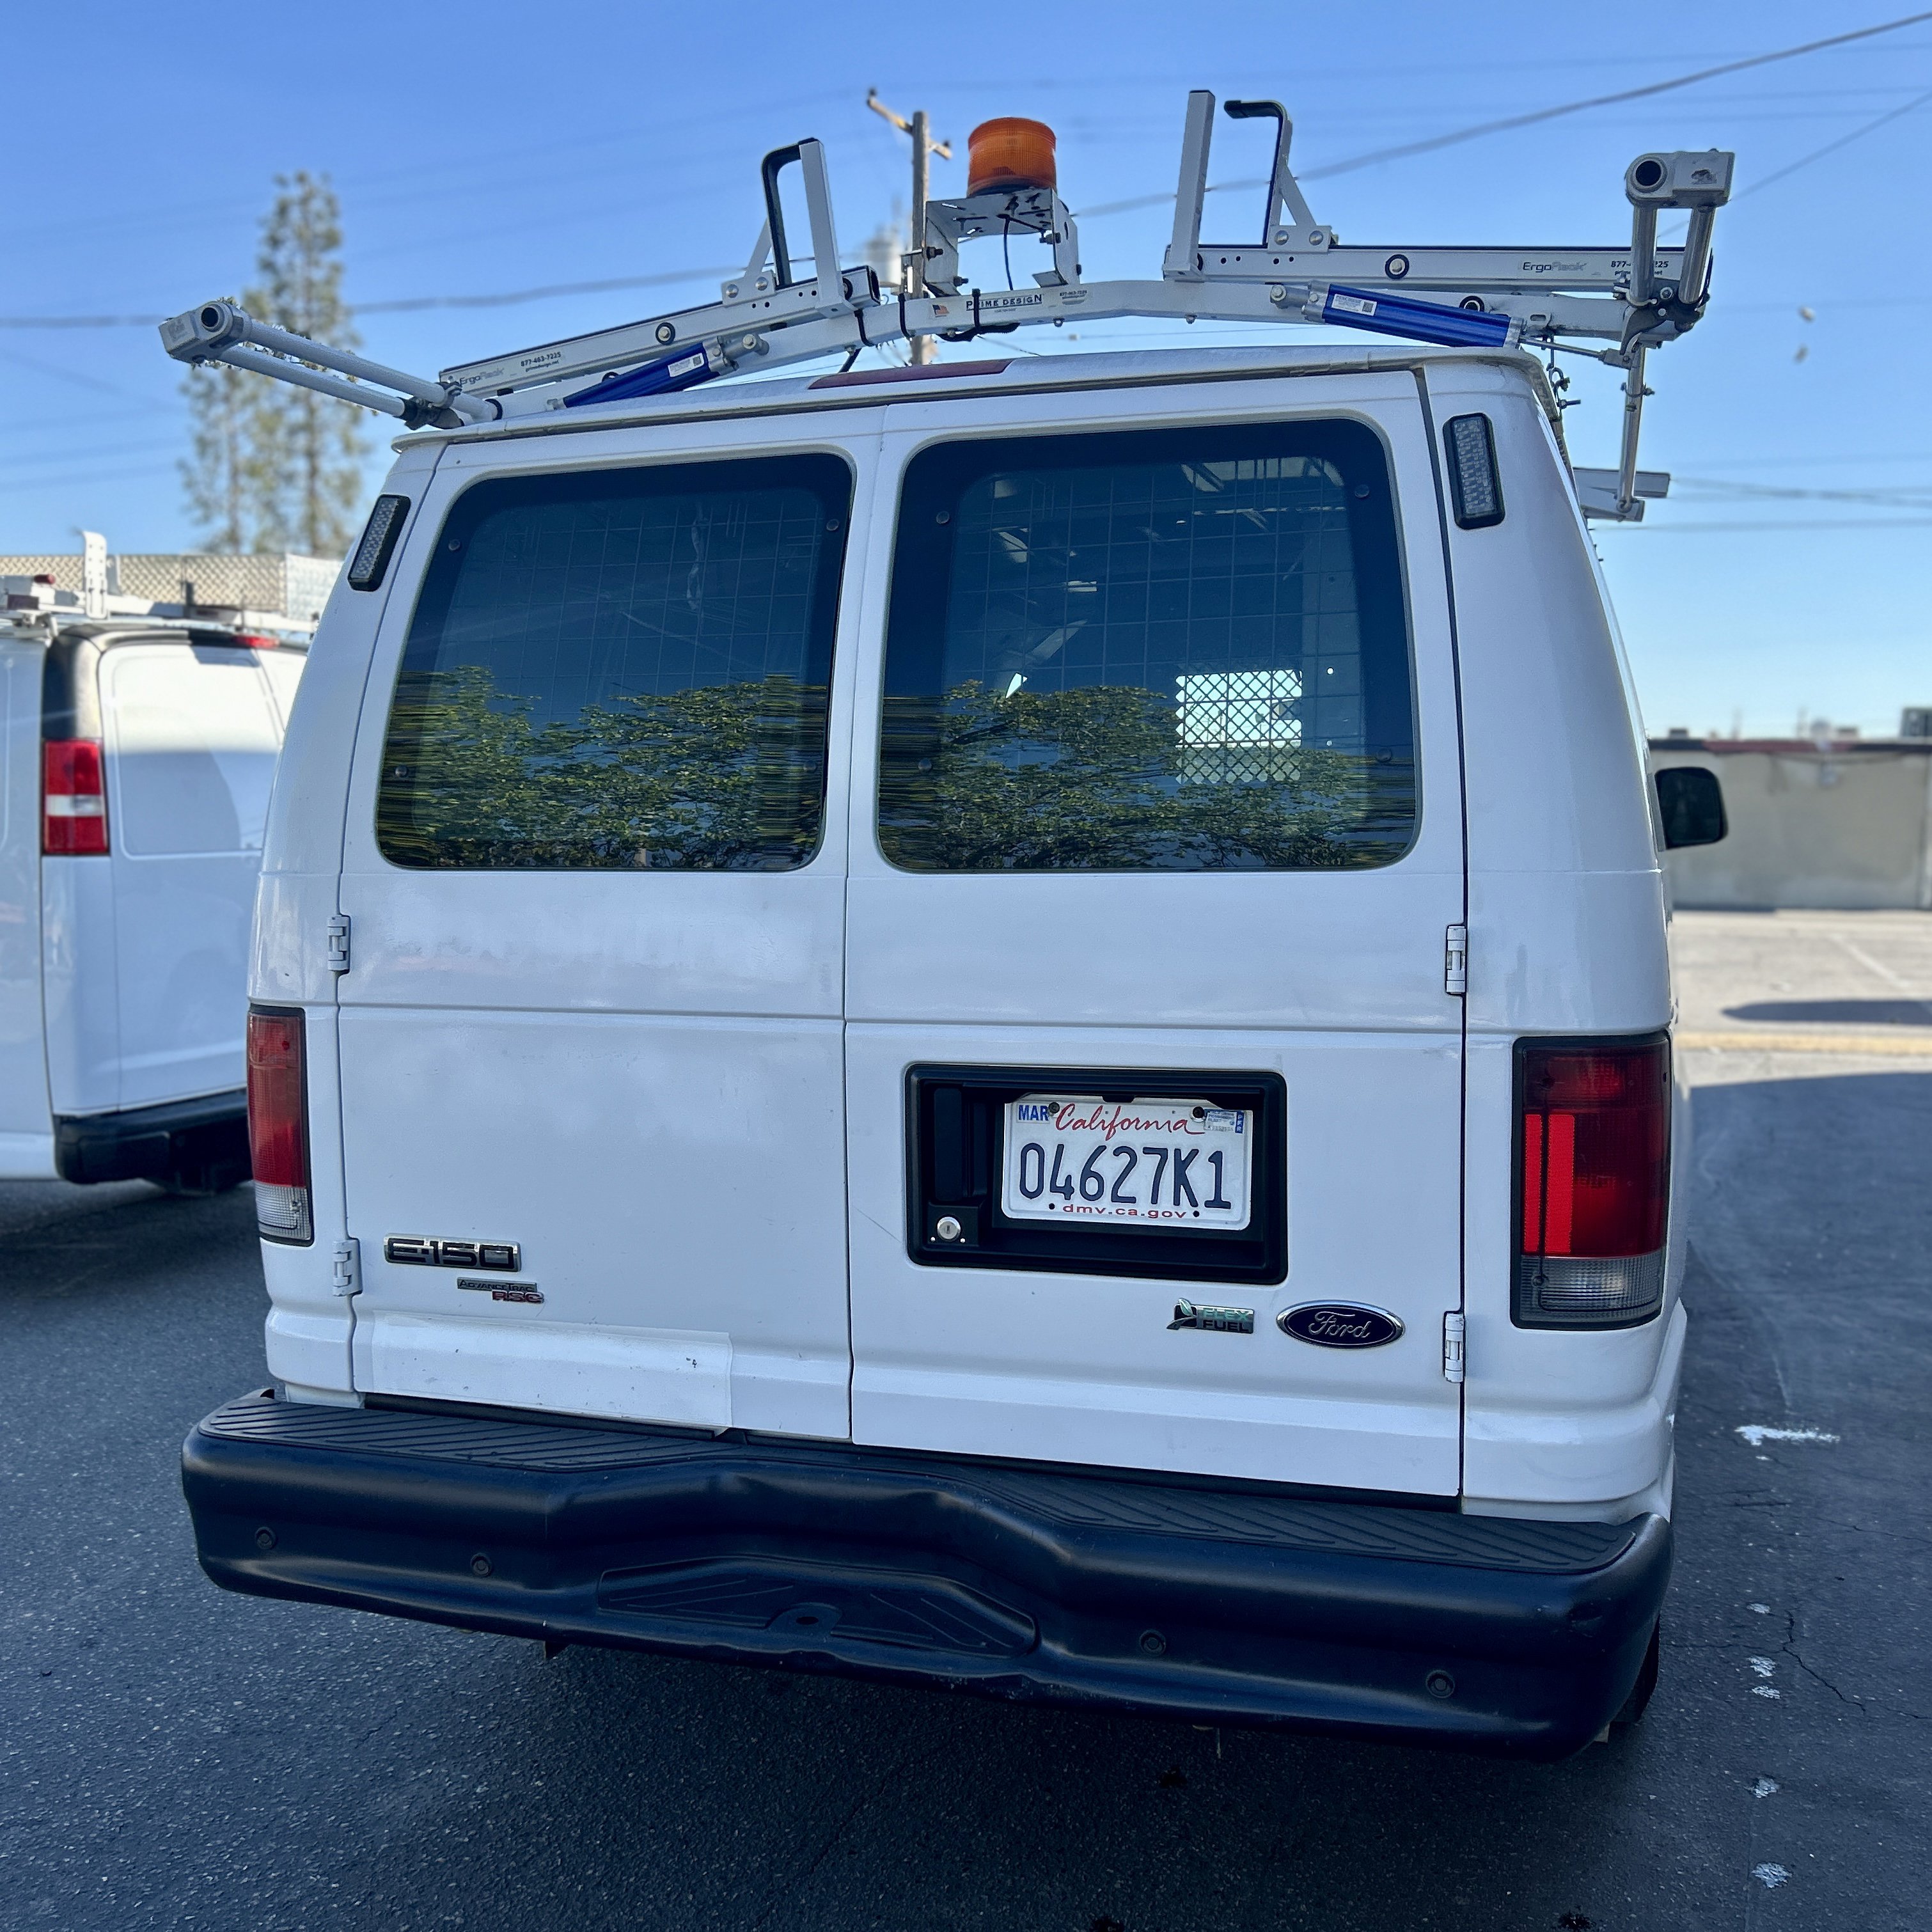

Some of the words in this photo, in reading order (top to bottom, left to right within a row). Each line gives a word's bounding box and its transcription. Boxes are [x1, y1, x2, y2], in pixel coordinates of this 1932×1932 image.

[966, 300, 998, 311] PIME
[1003, 294, 1042, 306] DESIGN
[521, 352, 562, 366] 877-463-7225
[1019, 1104, 1049, 1121] MAR
[1055, 1103, 1206, 1141] California
[1019, 1142, 1232, 1209] 04627K1
[1063, 1204, 1187, 1219] dmv.ca.gov
[387, 1237, 514, 1269] E-150
[492, 1291, 544, 1303] RSC
[1203, 1308, 1250, 1321] FLEX
[1203, 1320, 1248, 1332] FUEL
[1308, 1311, 1371, 1339] Ford
